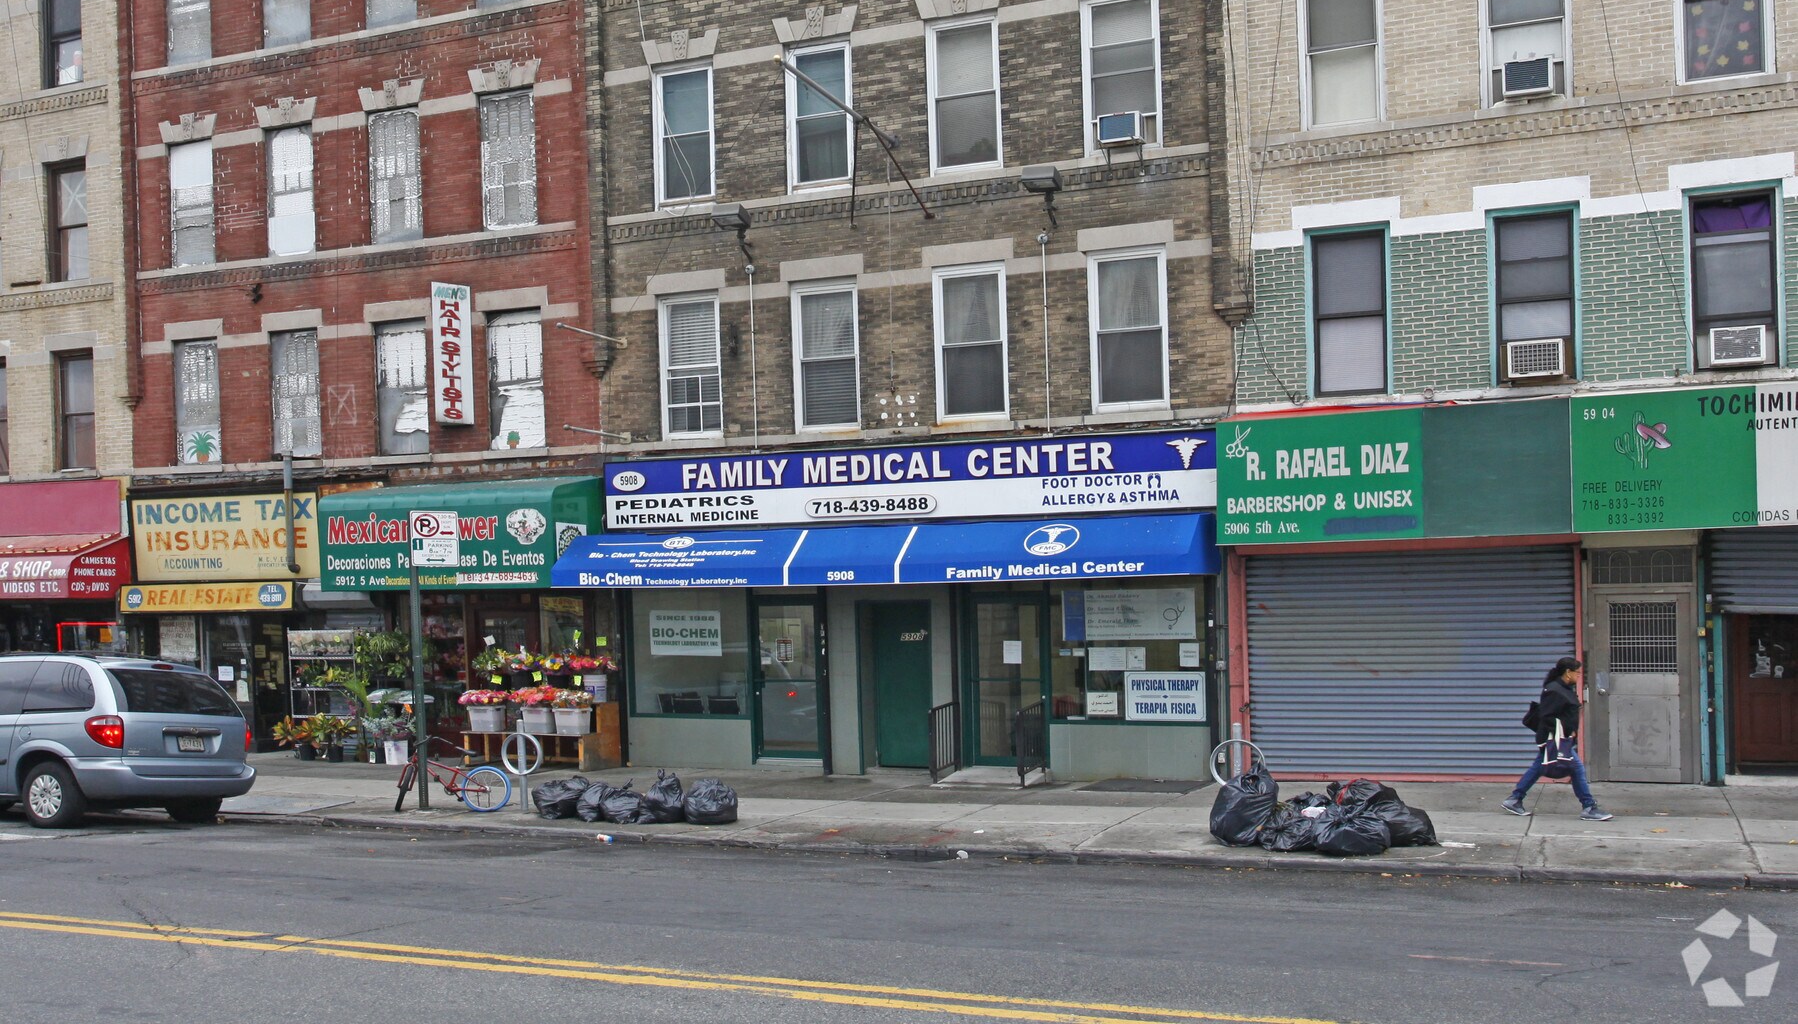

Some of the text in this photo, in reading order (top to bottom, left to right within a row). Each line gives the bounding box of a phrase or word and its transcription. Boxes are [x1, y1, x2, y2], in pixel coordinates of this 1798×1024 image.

[434, 286, 467, 300] MEN'S
[682, 441, 1114, 490] FAMILY MEDICAL CENTER
[1246, 442, 1409, 481] R. RAFAEL DIAZ
[620, 476, 638, 486] 5908
[1042, 474, 1142, 489] FOOT DOCTOR
[1582, 480, 1662, 493] FREE DELIVERY
[615, 495, 755, 510] PEDIATRICS
[1119, 489, 1179, 503] ASTHMA
[1227, 489, 1412, 514] BARBERSHOP & UNISEX
[1582, 496, 1664, 510] 718-833-3326
[136, 498, 313, 525] INCOME TAX
[812, 497, 928, 514] 718-439-8488
[616, 509, 759, 525] INTERNAL MEDICINE
[1608, 512, 1664, 525] 833-3392
[1732, 510, 1789, 523] COMIDAS
[1224, 521, 1300, 535] 5906 5th Ave.
[146, 527, 307, 552] INSURANCE
[81, 556, 116, 565] CAMISETAS
[327, 554, 391, 570] Decoraciones
[483, 550, 497, 567] De
[502, 549, 544, 567] Eventos
[611, 551, 635, 559] Chem
[639, 550, 689, 559] Technology
[13, 561, 51, 577] SHOP
[49, 568, 67, 577] CORP.
[164, 556, 223, 570] ACCOUNTING
[946, 560, 1144, 580] Family Medical Center
[74, 568, 116, 576] PHONE CARDS
[827, 571, 854, 581] 5908
[335, 576, 355, 586] 5912
[360, 576, 366, 586] 5
[369, 575, 385, 585] Ave
[579, 572, 642, 586] Bio-Chem
[645, 578, 689, 587] Technology
[2, 581, 61, 593] VIDEOS ETC.
[267, 585, 280, 593] TEL.
[147, 586, 258, 606] REAL ESTATE
[652, 628, 719, 639] BIO-CHEM
[901, 632, 923, 641] 5908
[1131, 679, 1199, 691] PHYSICAL THERAPY
[1135, 702, 1197, 715] TERAPIA FISICA
